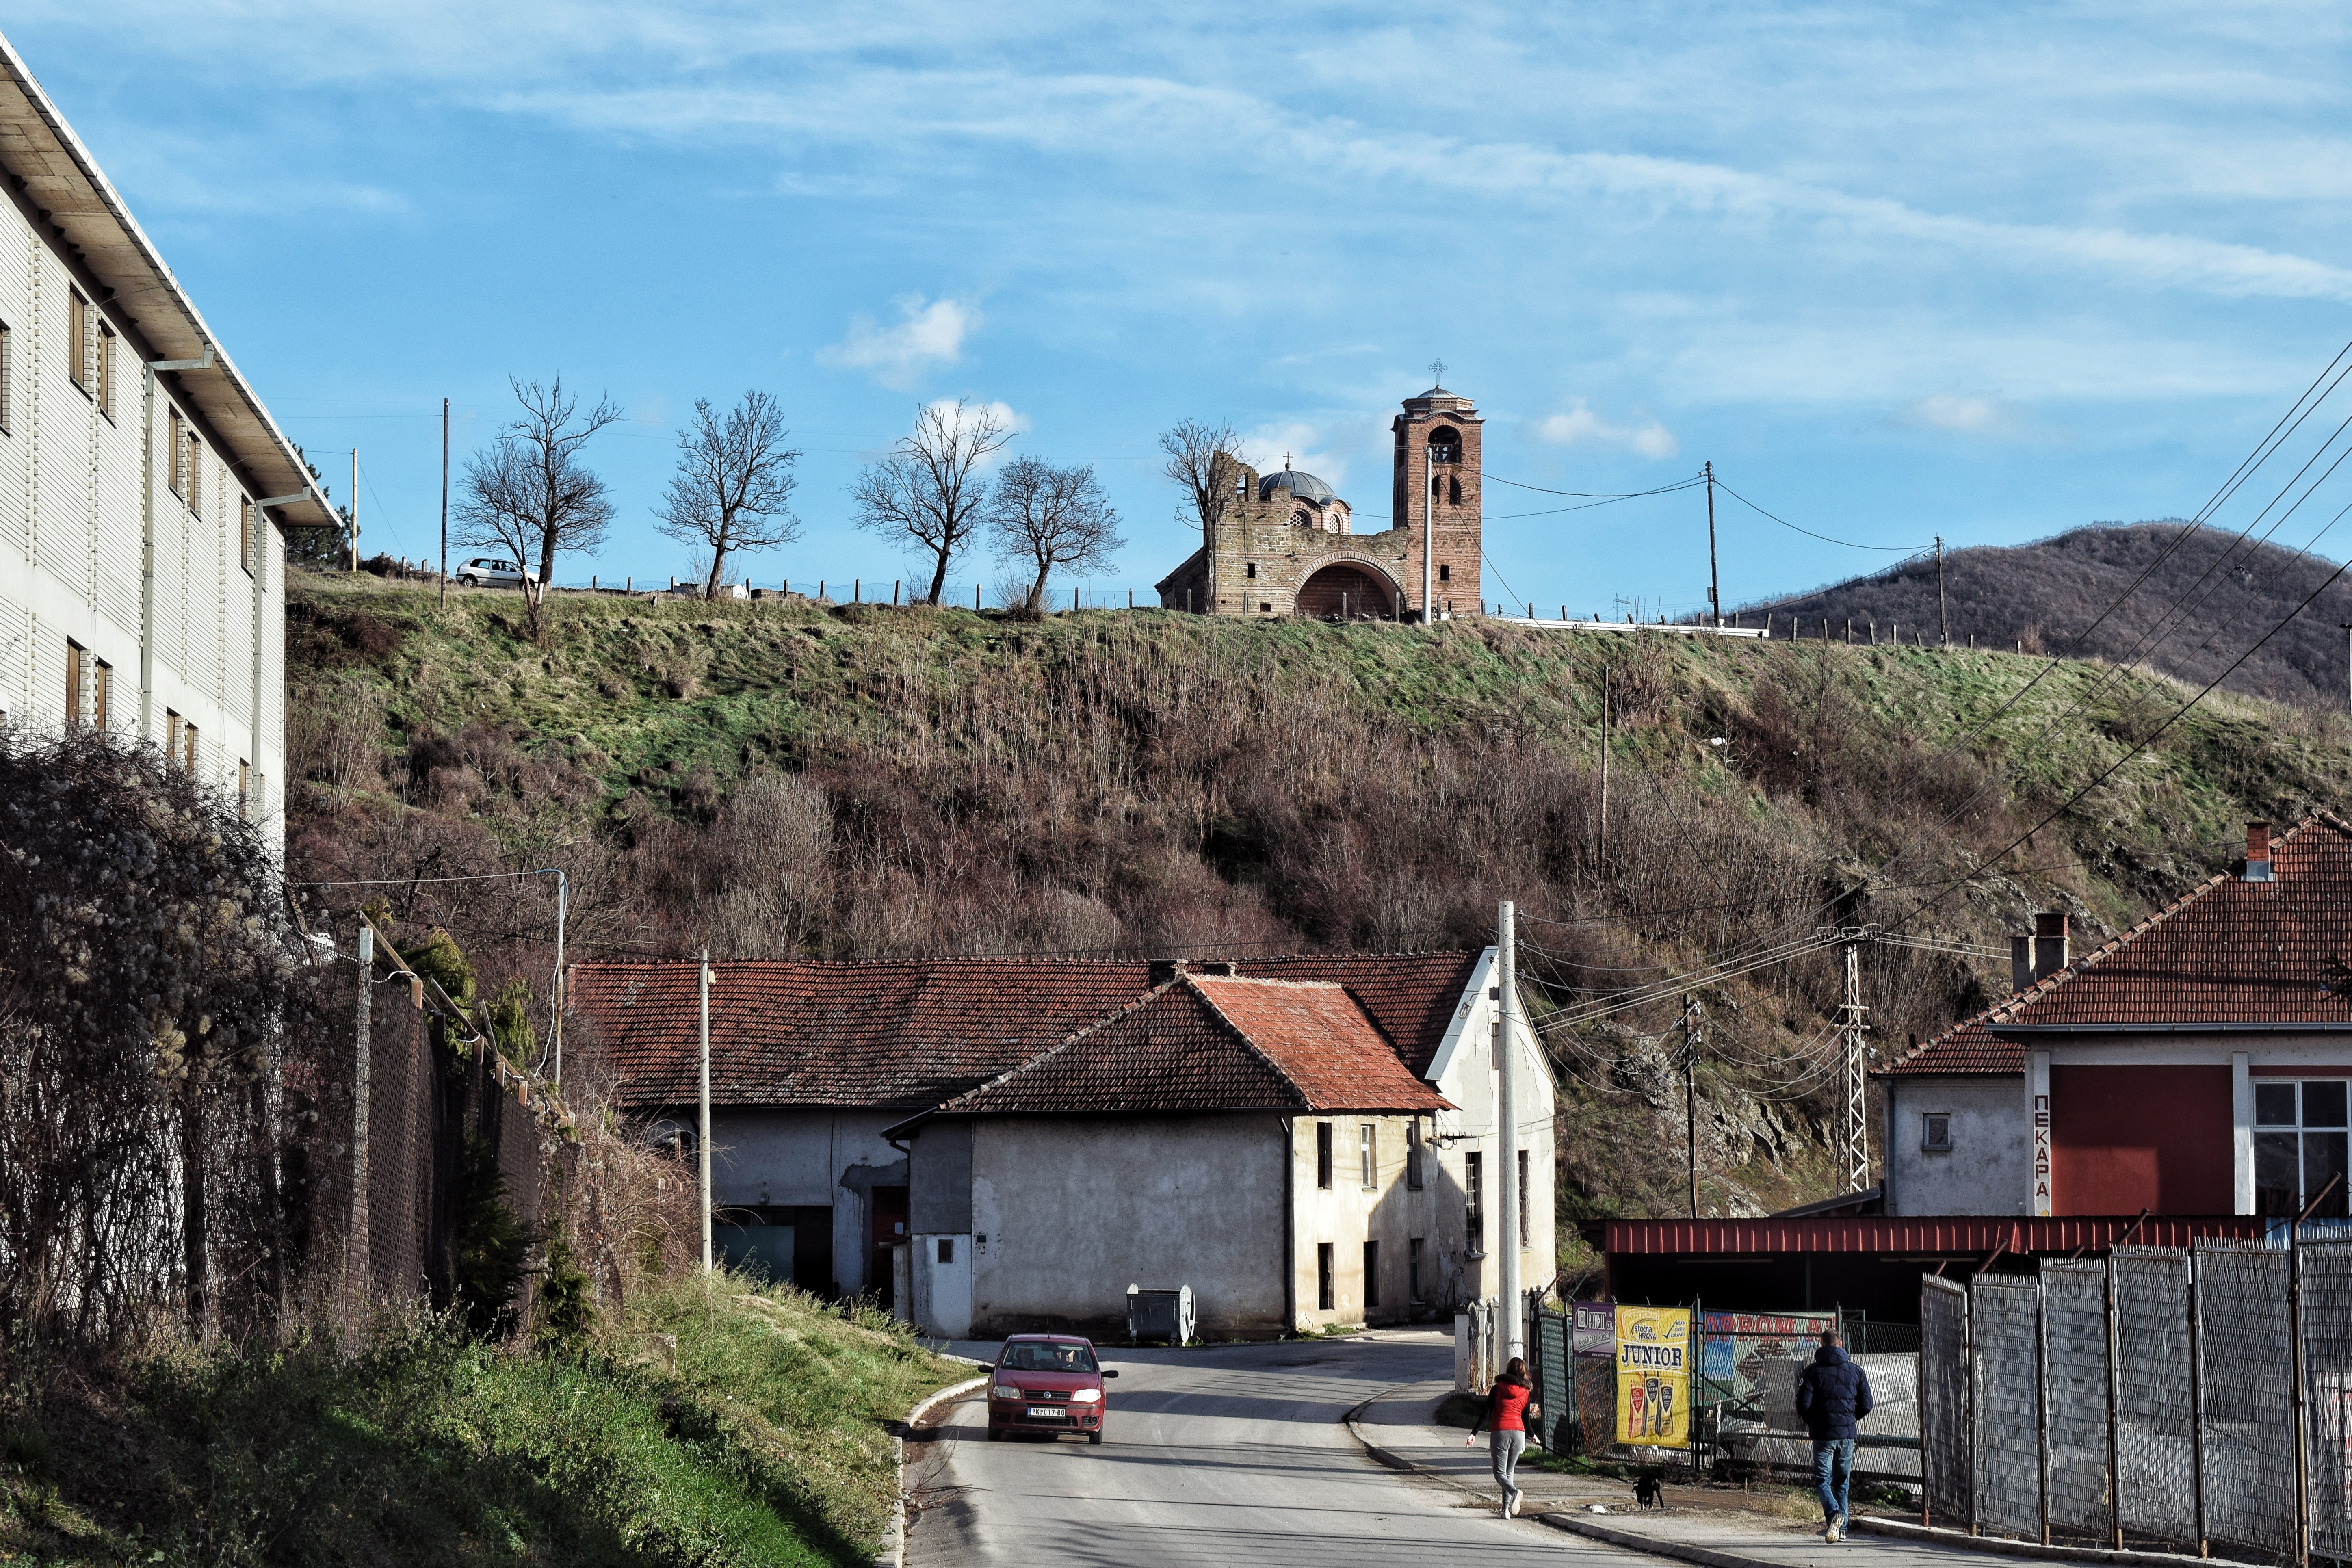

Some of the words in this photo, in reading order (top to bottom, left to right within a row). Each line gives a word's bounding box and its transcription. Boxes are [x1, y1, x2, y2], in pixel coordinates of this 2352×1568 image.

[2035, 1095, 2048, 1196] ПЕКАРА
[1589, 1312, 1606, 1329] PATENT
[1621, 1344, 1682, 1369] JUNIOR
